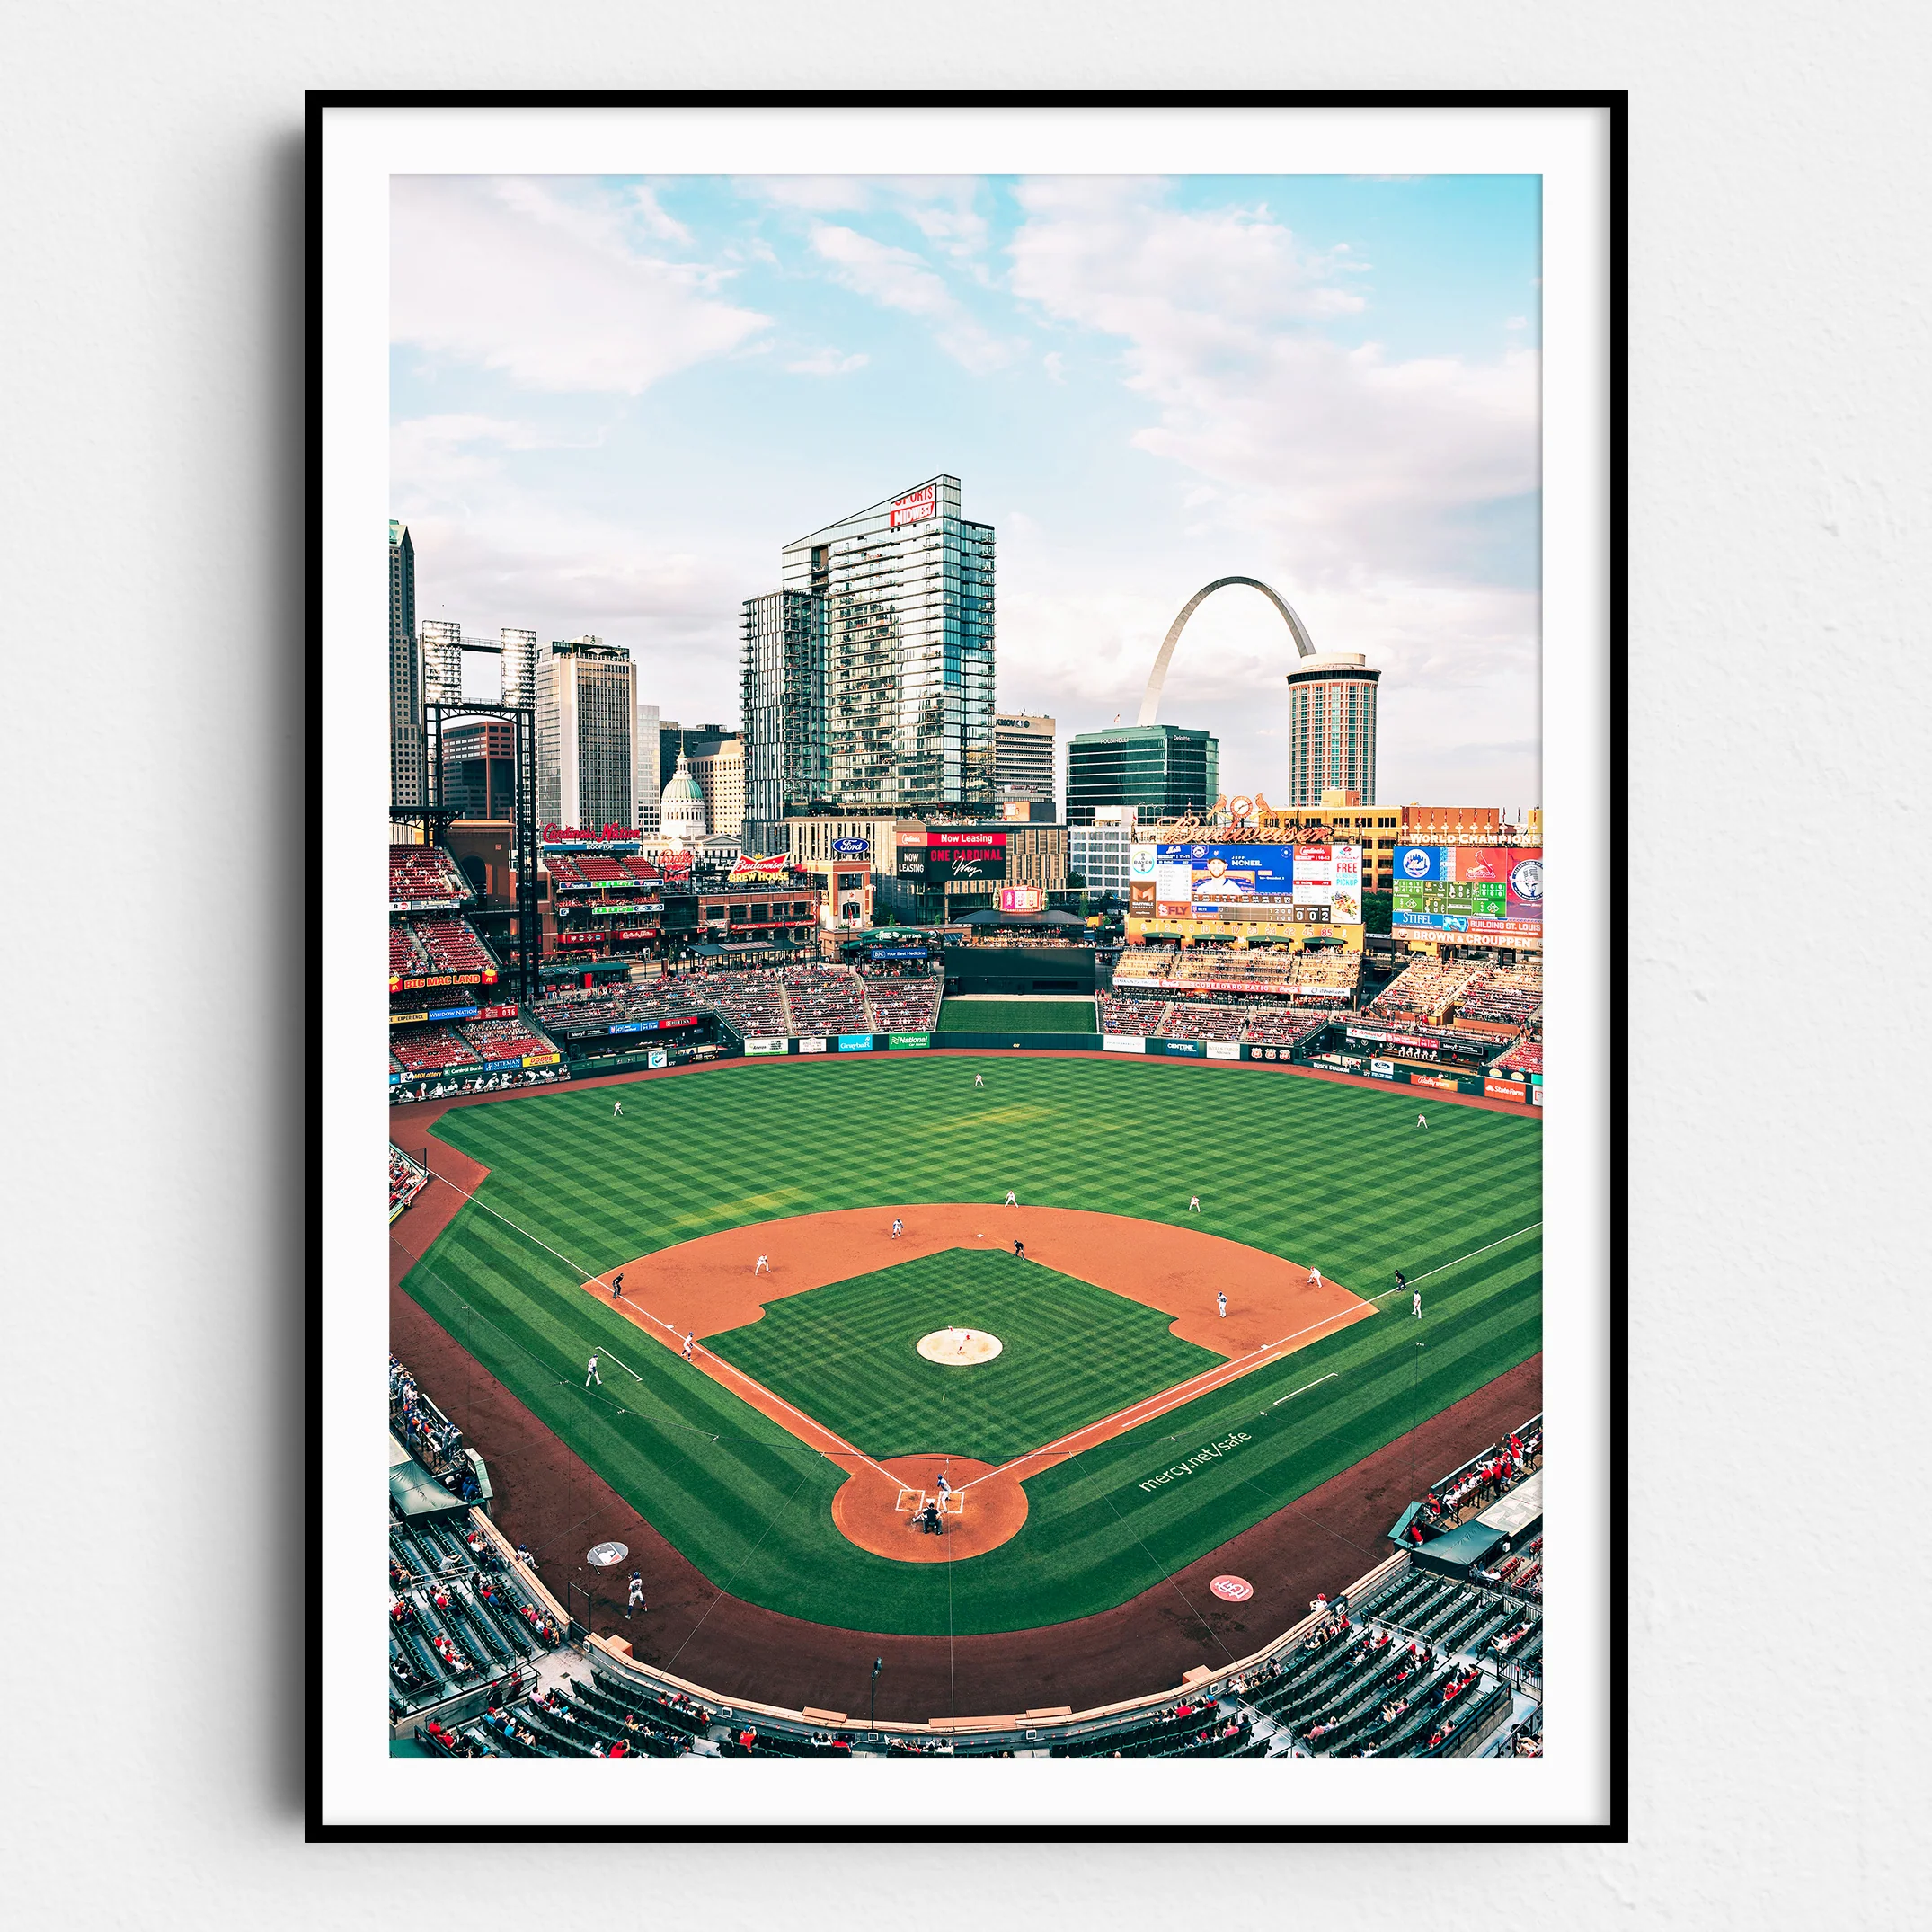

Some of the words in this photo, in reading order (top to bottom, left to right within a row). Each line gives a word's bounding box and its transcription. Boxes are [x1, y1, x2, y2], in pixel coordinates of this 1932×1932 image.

[893, 504, 933, 526] MIDWEST
[543, 822, 596, 844] Cardinals
[596, 822, 641, 843] Nation
[1157, 816, 1334, 844] Budweiser
[941, 833, 960, 843] Now
[961, 833, 993, 844] Leasing
[1410, 833, 1457, 844] WORLD
[1458, 833, 1542, 845] CHAMPIONS
[840, 839, 863, 851] Ford
[930, 849, 951, 862] ONE
[953, 848, 1004, 862] CARDINAL
[1299, 846, 1325, 855] Cardinals
[903, 853, 919, 862] NOW
[899, 864, 925, 873] LEASING
[951, 855, 983, 878] Way
[1336, 863, 1358, 873] FREE
[730, 873, 758, 883] BREW
[759, 872, 789, 882] HOUSE
[1335, 878, 1359, 886] PICKUP
[1168, 906, 1189, 915] FLY
[1296, 911, 1304, 920] 0
[1309, 911, 1316, 921] 0
[1321, 912, 1329, 921] 2
[1402, 912, 1433, 925] STIFEL
[1201, 924, 1210, 933] 10
[1216, 925, 1225, 934] 14
[1231, 926, 1240, 934] 17
[1247, 926, 1258, 935] 20
[1265, 926, 1276, 935] 24
[1284, 927, 1295, 935] 42
[1302, 928, 1314, 936] 45
[1321, 928, 1333, 937] 85
[1470, 920, 1505, 929] BUILDING
[1505, 922, 1517, 930] ST.
[1518, 923, 1541, 931] LOUIS
[1413, 931, 1455, 944] BROWN
[1457, 935, 1464, 944] &
[1466, 934, 1531, 948] CROUPPEN
[404, 979, 425, 990] BIG
[426, 976, 452, 987] MAC
[453, 974, 481, 985] LAND
[1189, 981, 1243, 989] SCOREBOARD
[430, 1010, 456, 1018] WINDOW
[456, 1007, 477, 1015] NATION
[501, 1007, 516, 1016] 036
[397, 1014, 424, 1022] EXPERIENCE
[899, 1035, 928, 1043] National
[493, 1059, 520, 1067] SITEMAN
[530, 1055, 553, 1063] DOBBS
[451, 1067, 468, 1075] Central
[1328, 1065, 1350, 1073] STADIUM
[414, 1070, 443, 1079] MOLottery
[1494, 1086, 1510, 1094] State
[1510, 1086, 1524, 1096] Farm
[1139, 1431, 1253, 1493] mercy.net/safe
